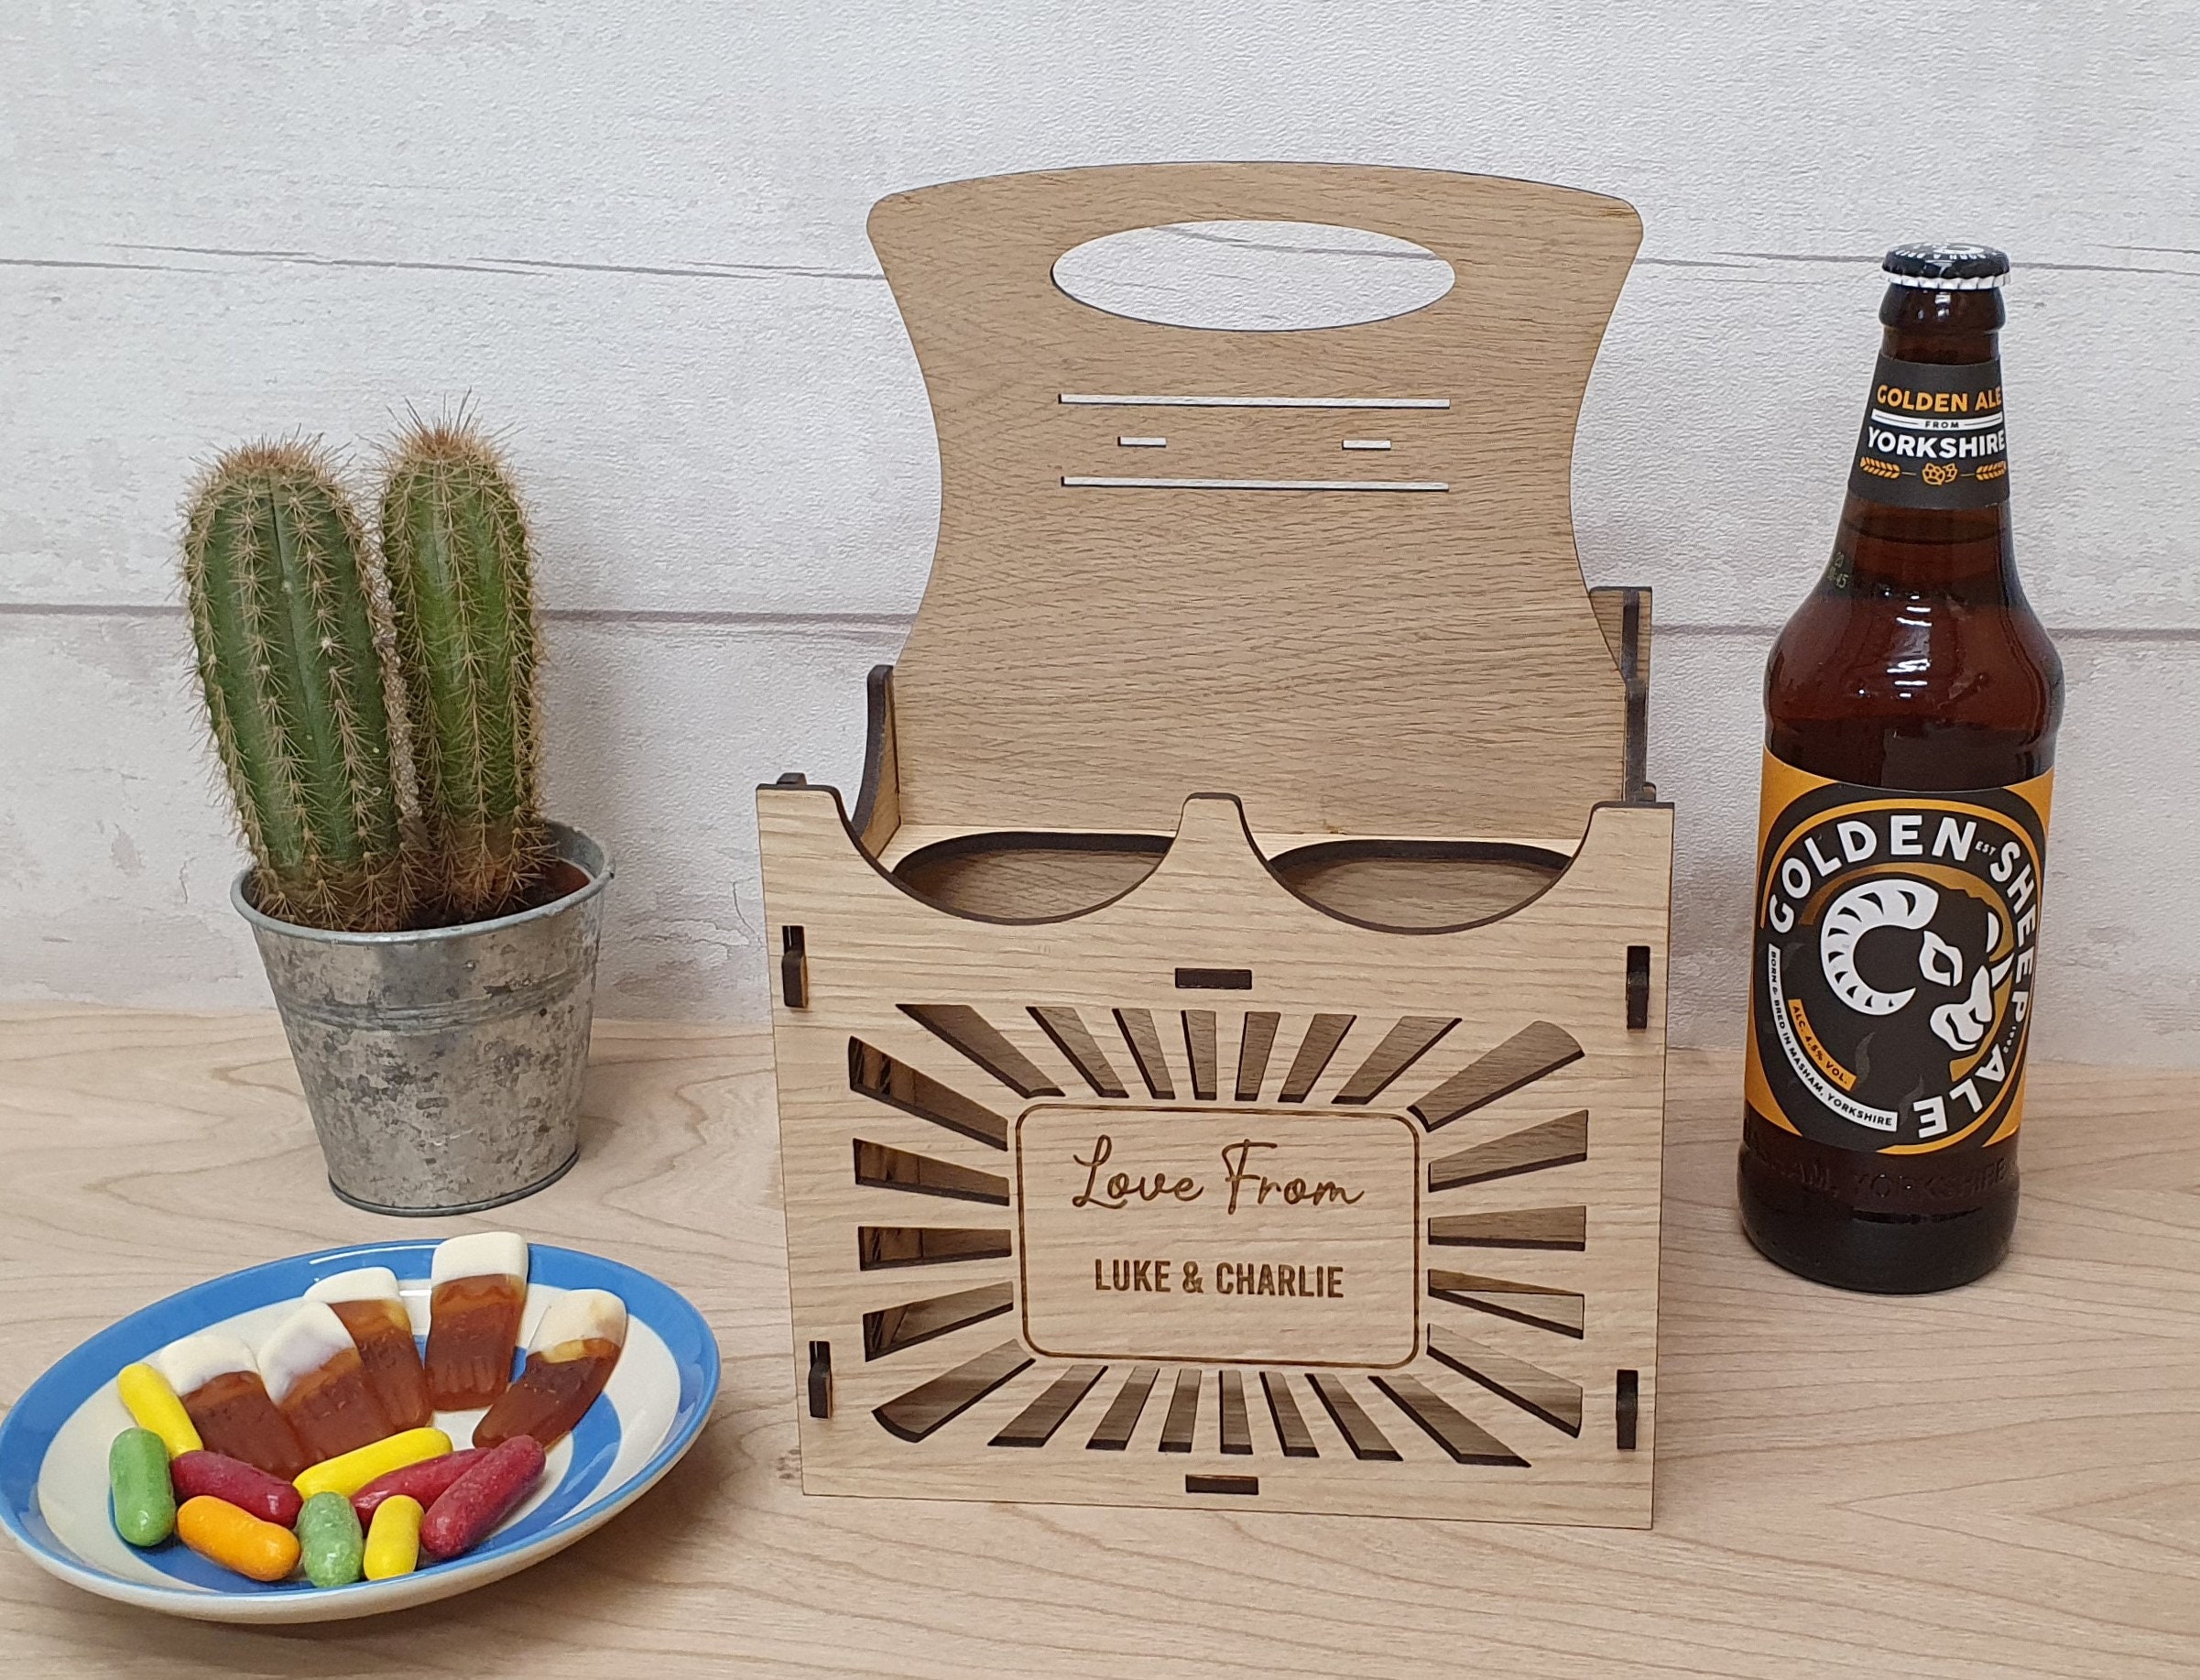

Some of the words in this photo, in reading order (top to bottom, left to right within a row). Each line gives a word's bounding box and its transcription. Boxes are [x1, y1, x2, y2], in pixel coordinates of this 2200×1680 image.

[1878, 385, 1968, 412] GOLDEN
[1975, 386, 2003, 410] ALE
[1924, 420, 1960, 429] FROM
[1868, 426, 2006, 458] YORKSHIRE
[1769, 814, 1977, 934] GOLDEN
[1975, 840, 1997, 856] EST
[1989, 841, 2037, 1023] SHEEP
[1773, 999, 1786, 1030] BRED
[1782, 1032, 1792, 1045] IN
[1789, 1047, 1824, 1096] MASHAM,
[1826, 1092, 1892, 1126] YORKSHIRE
[1792, 1005, 1806, 1032] ALC.
[1805, 1035, 1824, 1062] 4.5%
[1825, 1061, 1848, 1085] VOL.
[1912, 1042, 2007, 1139] ALE
[1072, 1134, 1204, 1209] Love
[1221, 1139, 1365, 1216] From
[1095, 1258, 1171, 1293] LUKE
[1182, 1260, 1204, 1294] &
[1216, 1261, 1344, 1299] CHARLIE
